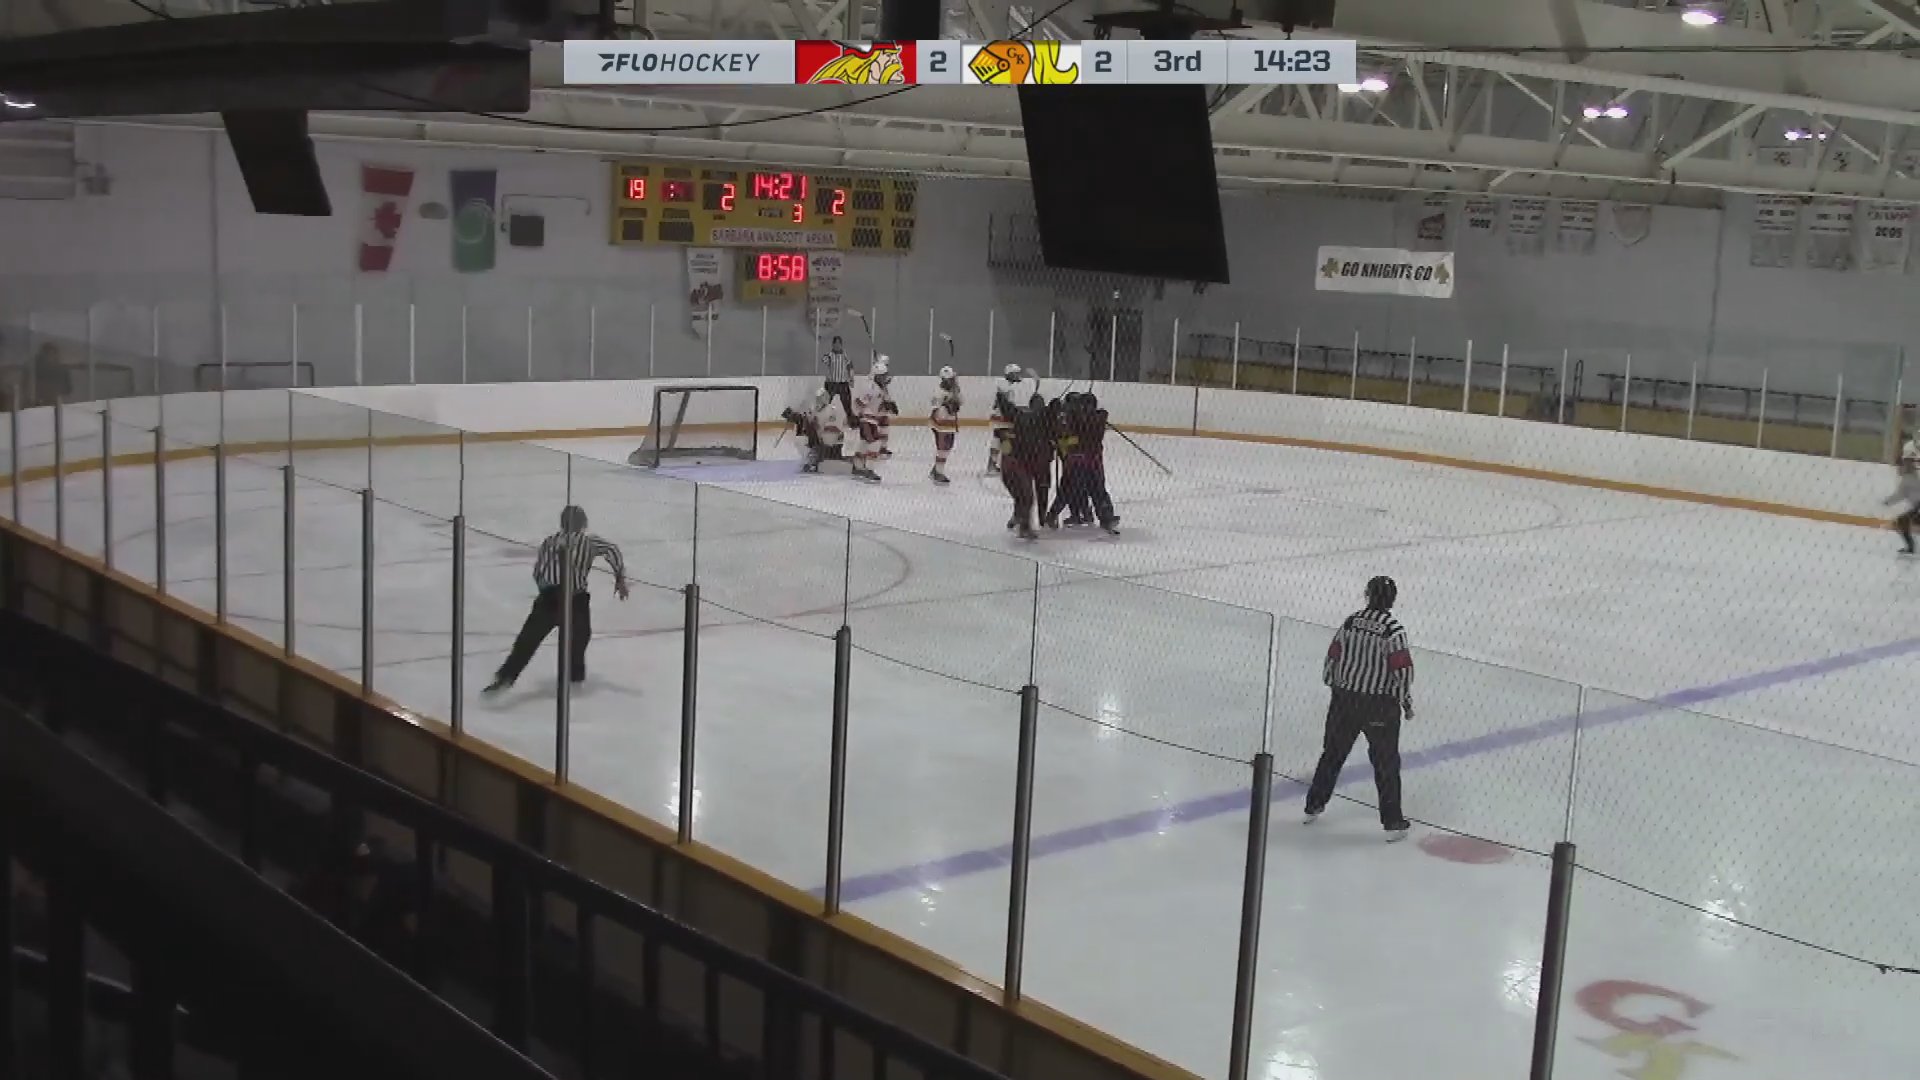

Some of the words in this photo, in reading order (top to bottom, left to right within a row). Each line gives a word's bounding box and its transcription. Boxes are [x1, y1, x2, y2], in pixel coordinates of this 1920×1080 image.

[629, 178, 645, 199] 19
[720, 183, 736, 211] 2
[754, 173, 807, 200] 14:21
[792, 203, 804, 223] 3
[831, 189, 846, 215] 2
[776, 231, 804, 244] SCOTT
[806, 232, 835, 245] ARENA
[758, 254, 806, 281] 8:58
[1340, 261, 1360, 277] GO
[1360, 263, 1413, 280] KNIGHTS
[1413, 265, 1434, 281] GO
